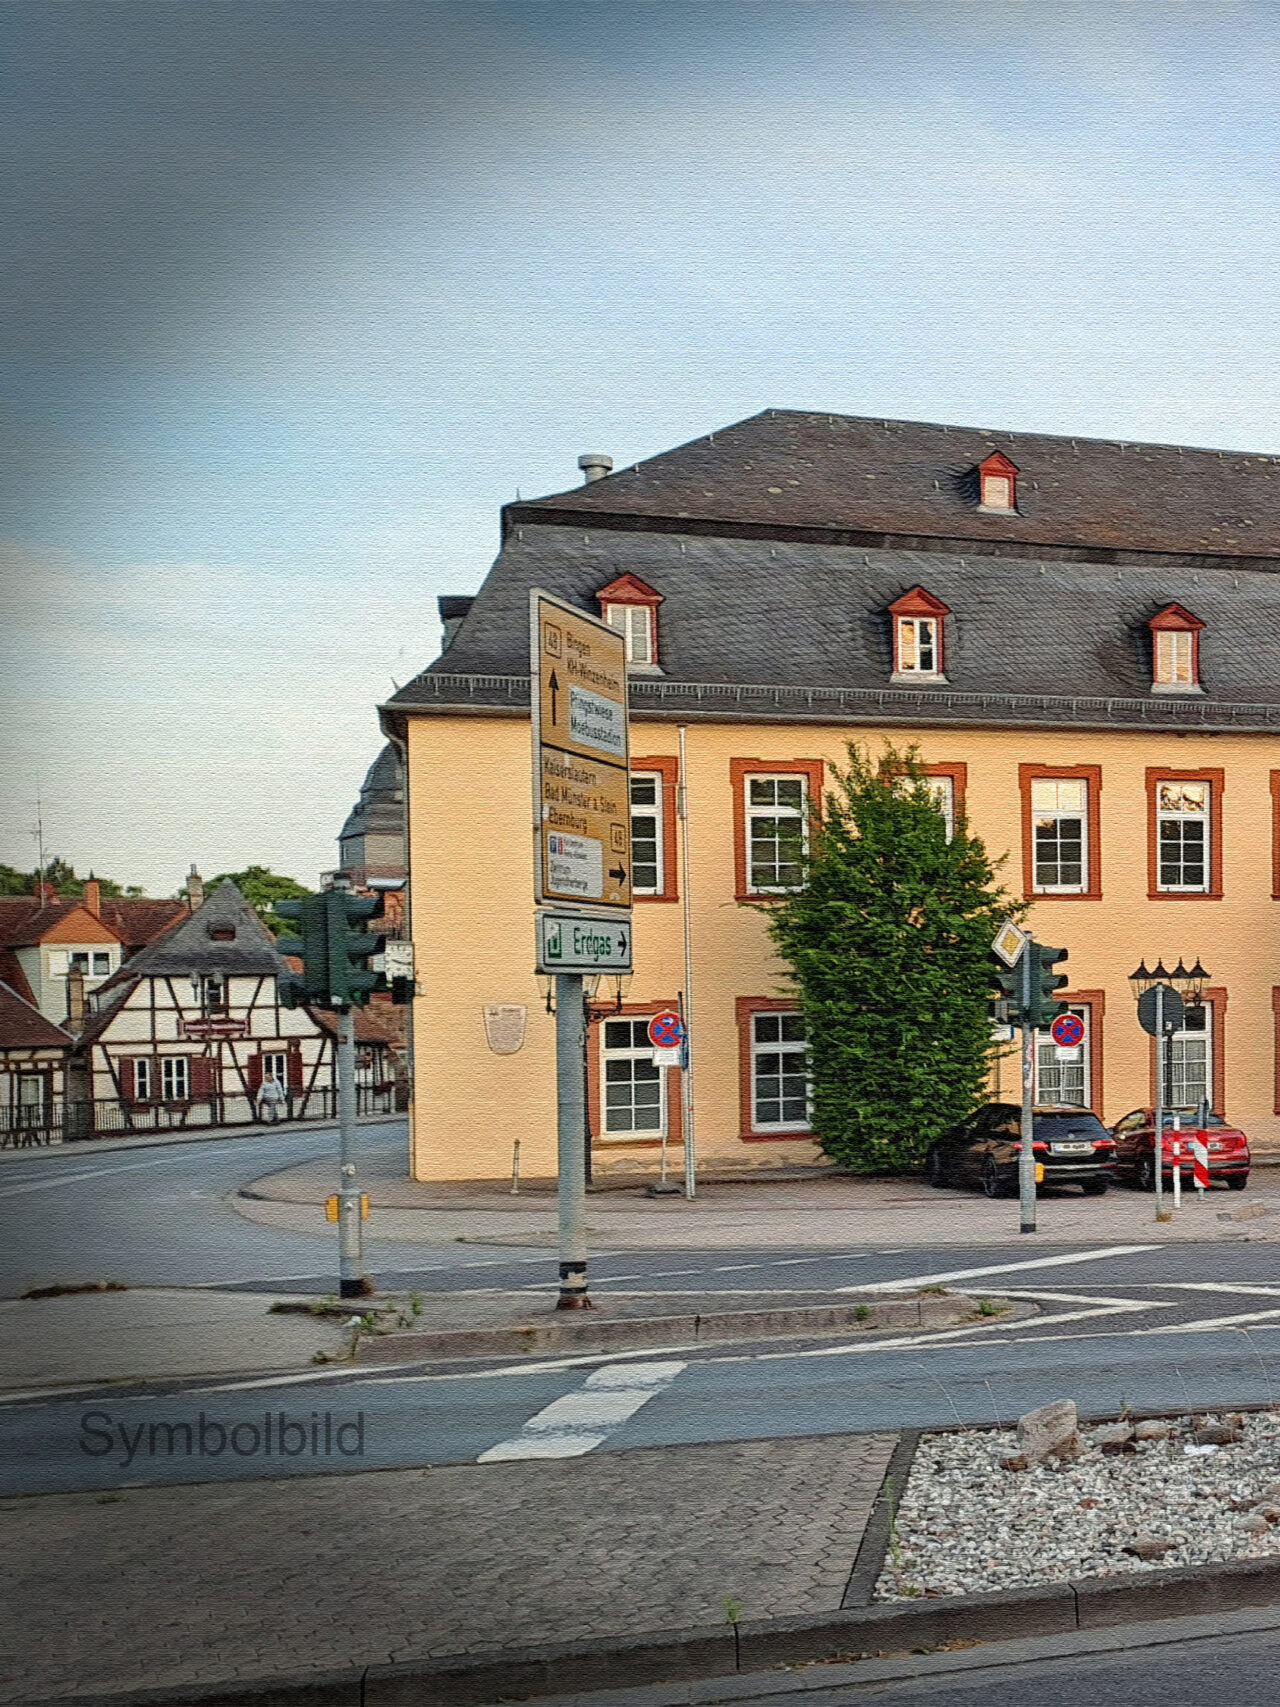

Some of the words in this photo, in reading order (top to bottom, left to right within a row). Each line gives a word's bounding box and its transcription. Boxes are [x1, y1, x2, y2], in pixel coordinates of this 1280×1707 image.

[567, 631, 591, 658] Bingen
[545, 782, 559, 801] Bad
[574, 926, 612, 962] Erdgas
